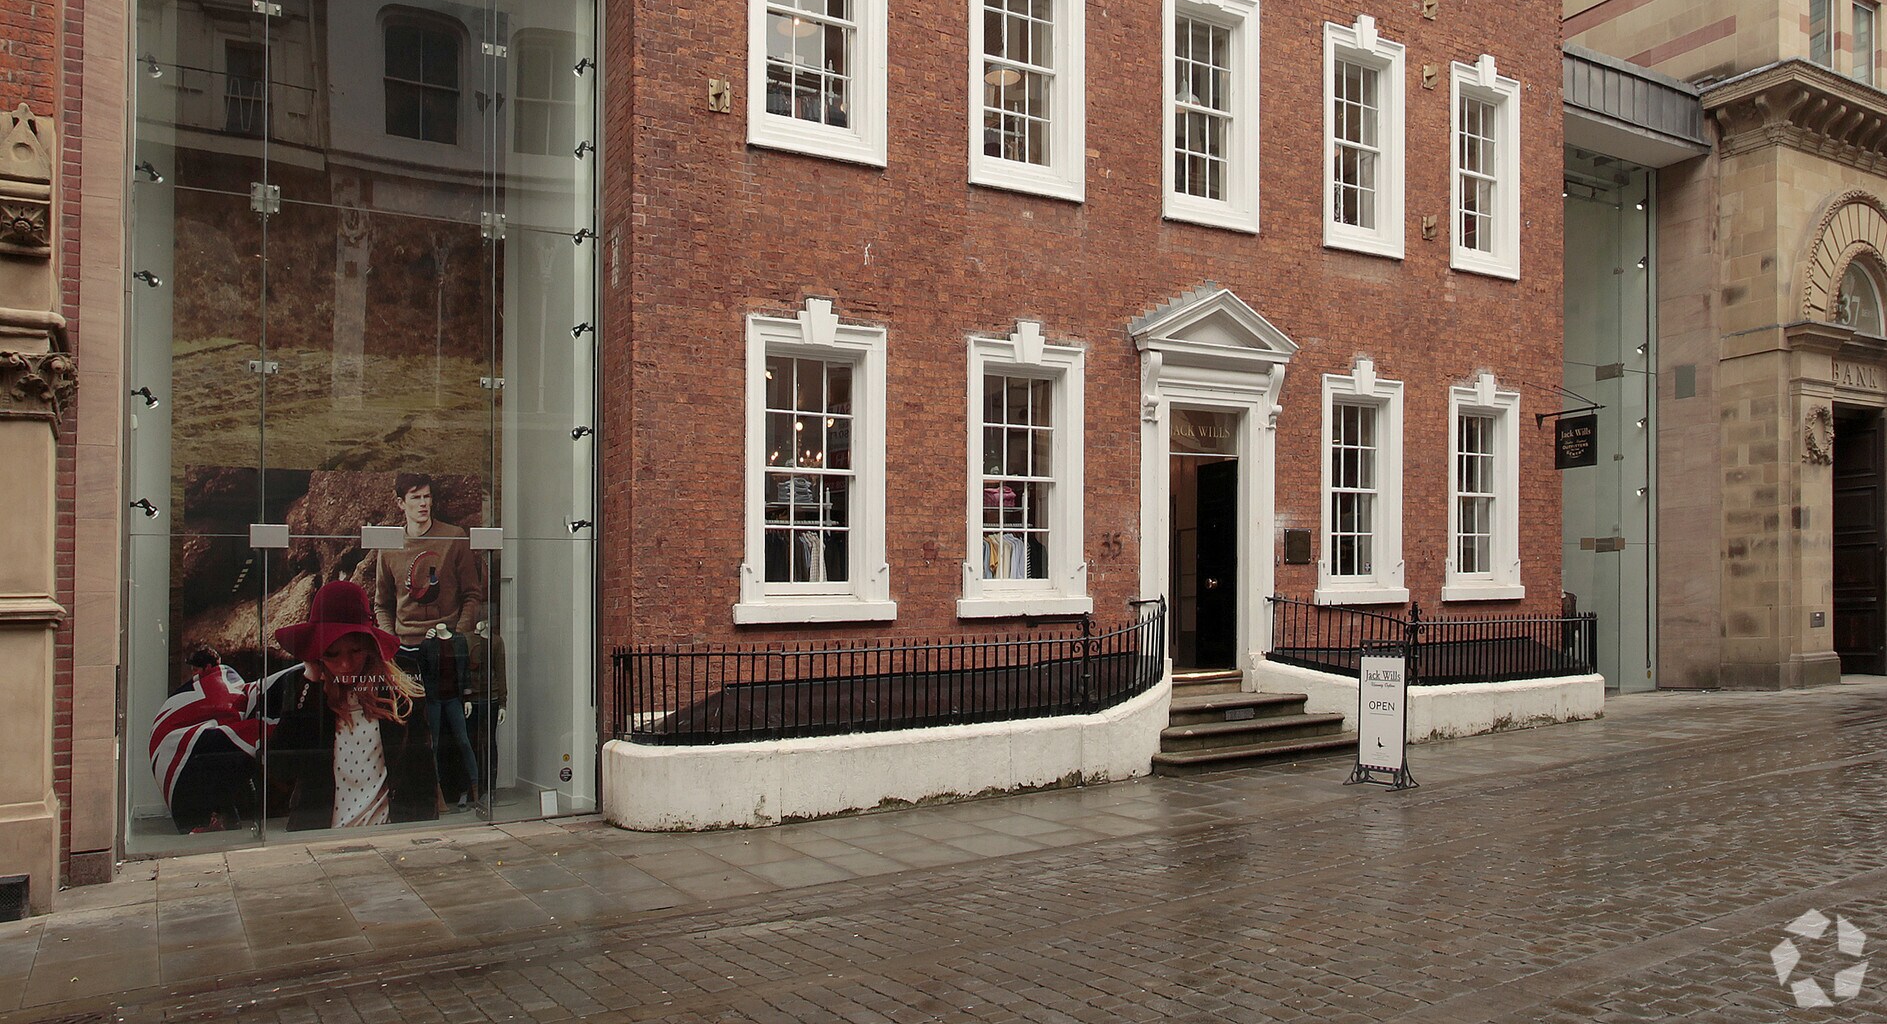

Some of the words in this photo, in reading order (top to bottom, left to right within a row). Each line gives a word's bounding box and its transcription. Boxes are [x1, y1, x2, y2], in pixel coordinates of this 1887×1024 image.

[1841, 293, 1860, 326] 37
[1832, 361, 1877, 389] BANK
[1198, 425, 1231, 438] WILLS
[1560, 429, 1574, 441] Jack
[1575, 427, 1591, 436] Wills
[1101, 532, 1122, 560] 35
[333, 675, 386, 684] AUTUMN
[1365, 669, 1381, 682] Jack
[1382, 670, 1401, 681] Wills
[1368, 700, 1395, 711] OPEN
